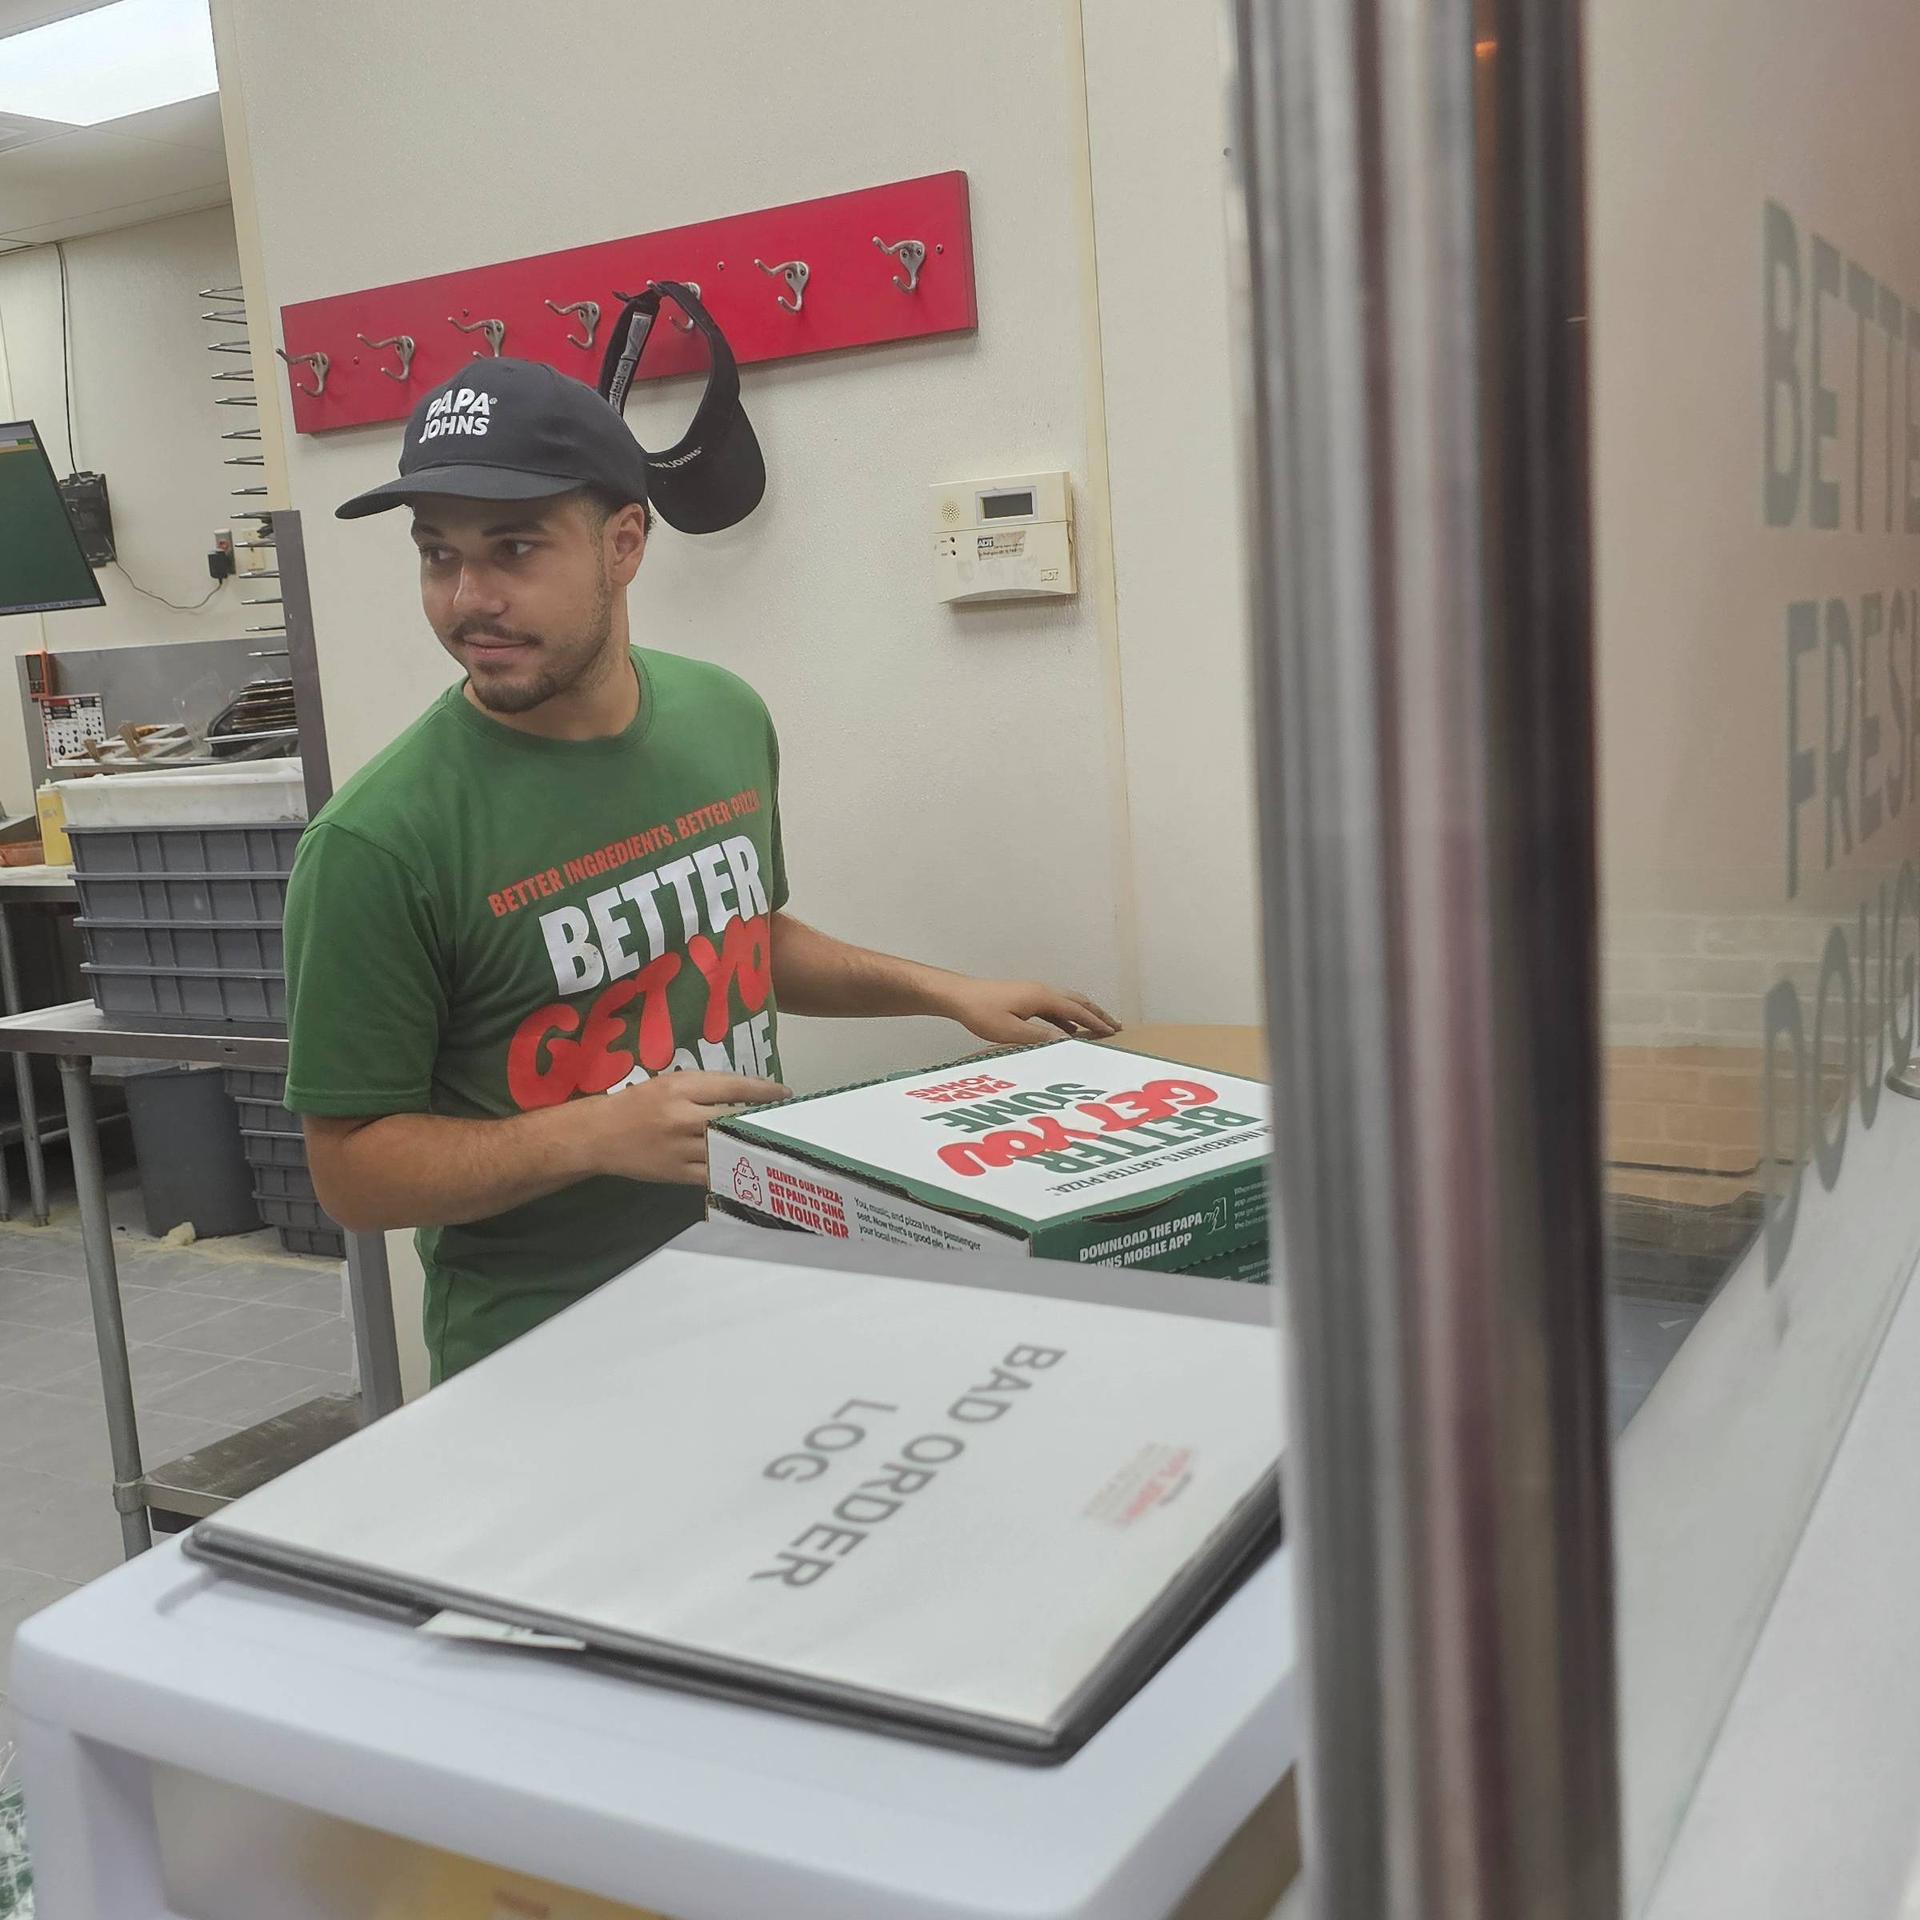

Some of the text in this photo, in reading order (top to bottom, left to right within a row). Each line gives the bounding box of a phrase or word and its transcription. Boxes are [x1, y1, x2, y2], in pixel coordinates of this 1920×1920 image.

[419, 415, 490, 444] JOHNS
[978, 537, 993, 548] ADT
[488, 866, 565, 918] BETTER
[563, 825, 678, 884] INGREDIENTS.
[675, 800, 733, 840] BETTER
[539, 836, 769, 997] BETTER
[507, 952, 682, 1112] GET
[904, 1074, 997, 1099] JOHNS
[920, 1079, 1016, 1104] PAPA
[1763, 858, 1920, 1289] DOUG
[922, 1083, 1108, 1133] SOME
[938, 1079, 1219, 1176] GET YOU
[1013, 1106, 1264, 1173] BETTER
[766, 1166, 798, 1188] DELIVER
[799, 1179, 817, 1195] OUR
[1102, 1160, 1159, 1181] BETTER
[768, 1181, 846, 1222] GET PAID TO SING
[771, 1196, 849, 1239] IN YOUR CAR
[874, 1229, 891, 1242] local
[905, 1217, 922, 1231] pizza
[913, 1232, 931, 1246] good
[1080, 1211, 1203, 1262] DOWNLOAD THE PAPA
[1124, 1239, 1167, 1266] MOBILE
[1168, 1232, 1193, 1251] APP
[947, 1342, 1067, 1424] BAD
[762, 1397, 899, 1484] LOG
[749, 1433, 966, 1589] ORDER
